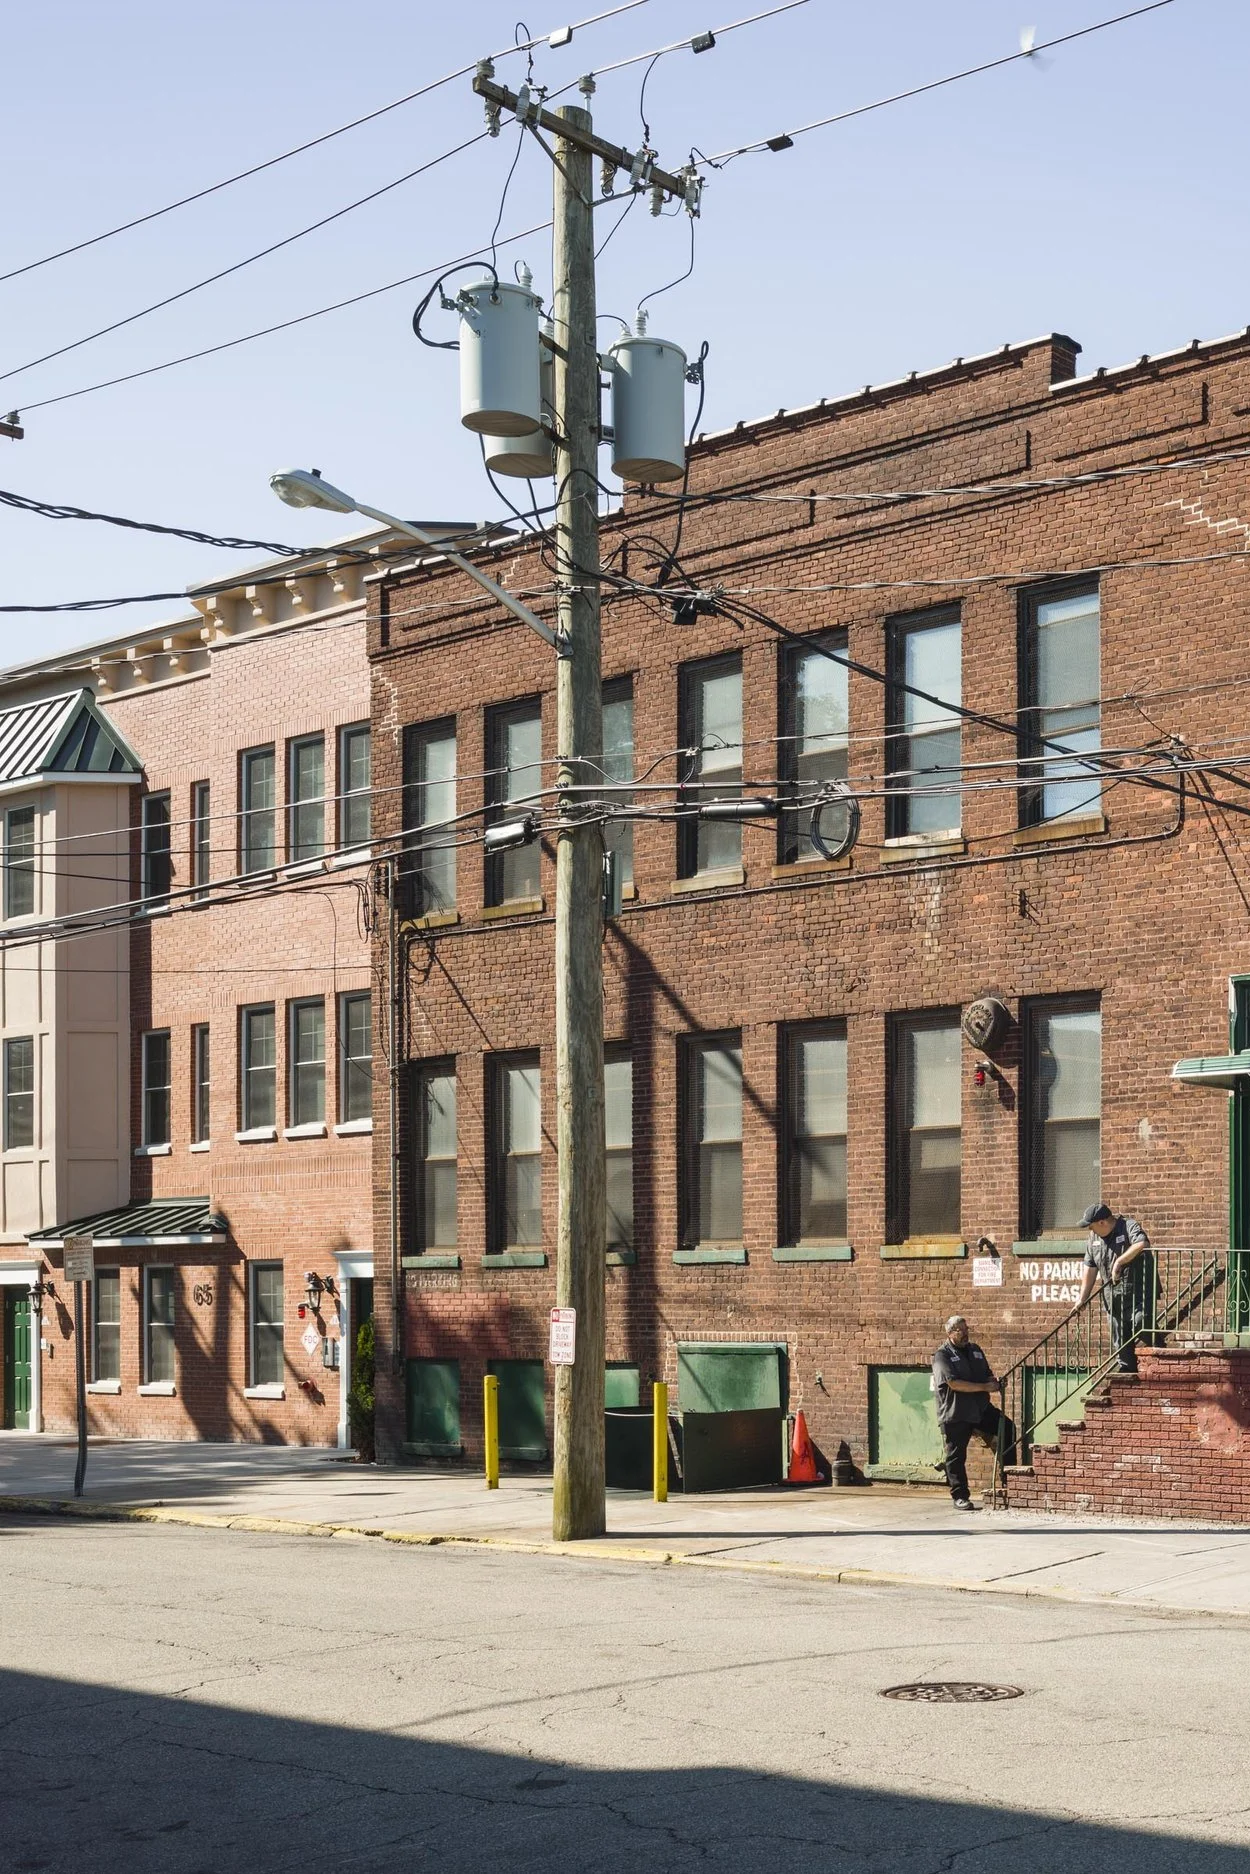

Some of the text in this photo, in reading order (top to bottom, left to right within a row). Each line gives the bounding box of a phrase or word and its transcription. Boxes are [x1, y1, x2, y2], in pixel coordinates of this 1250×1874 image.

[1020, 1261, 1100, 1281] NO PARKI
[194, 1284, 213, 1306] 65
[1031, 1283, 1081, 1303] PLEAS
[303, 1336, 317, 1344] FDC
